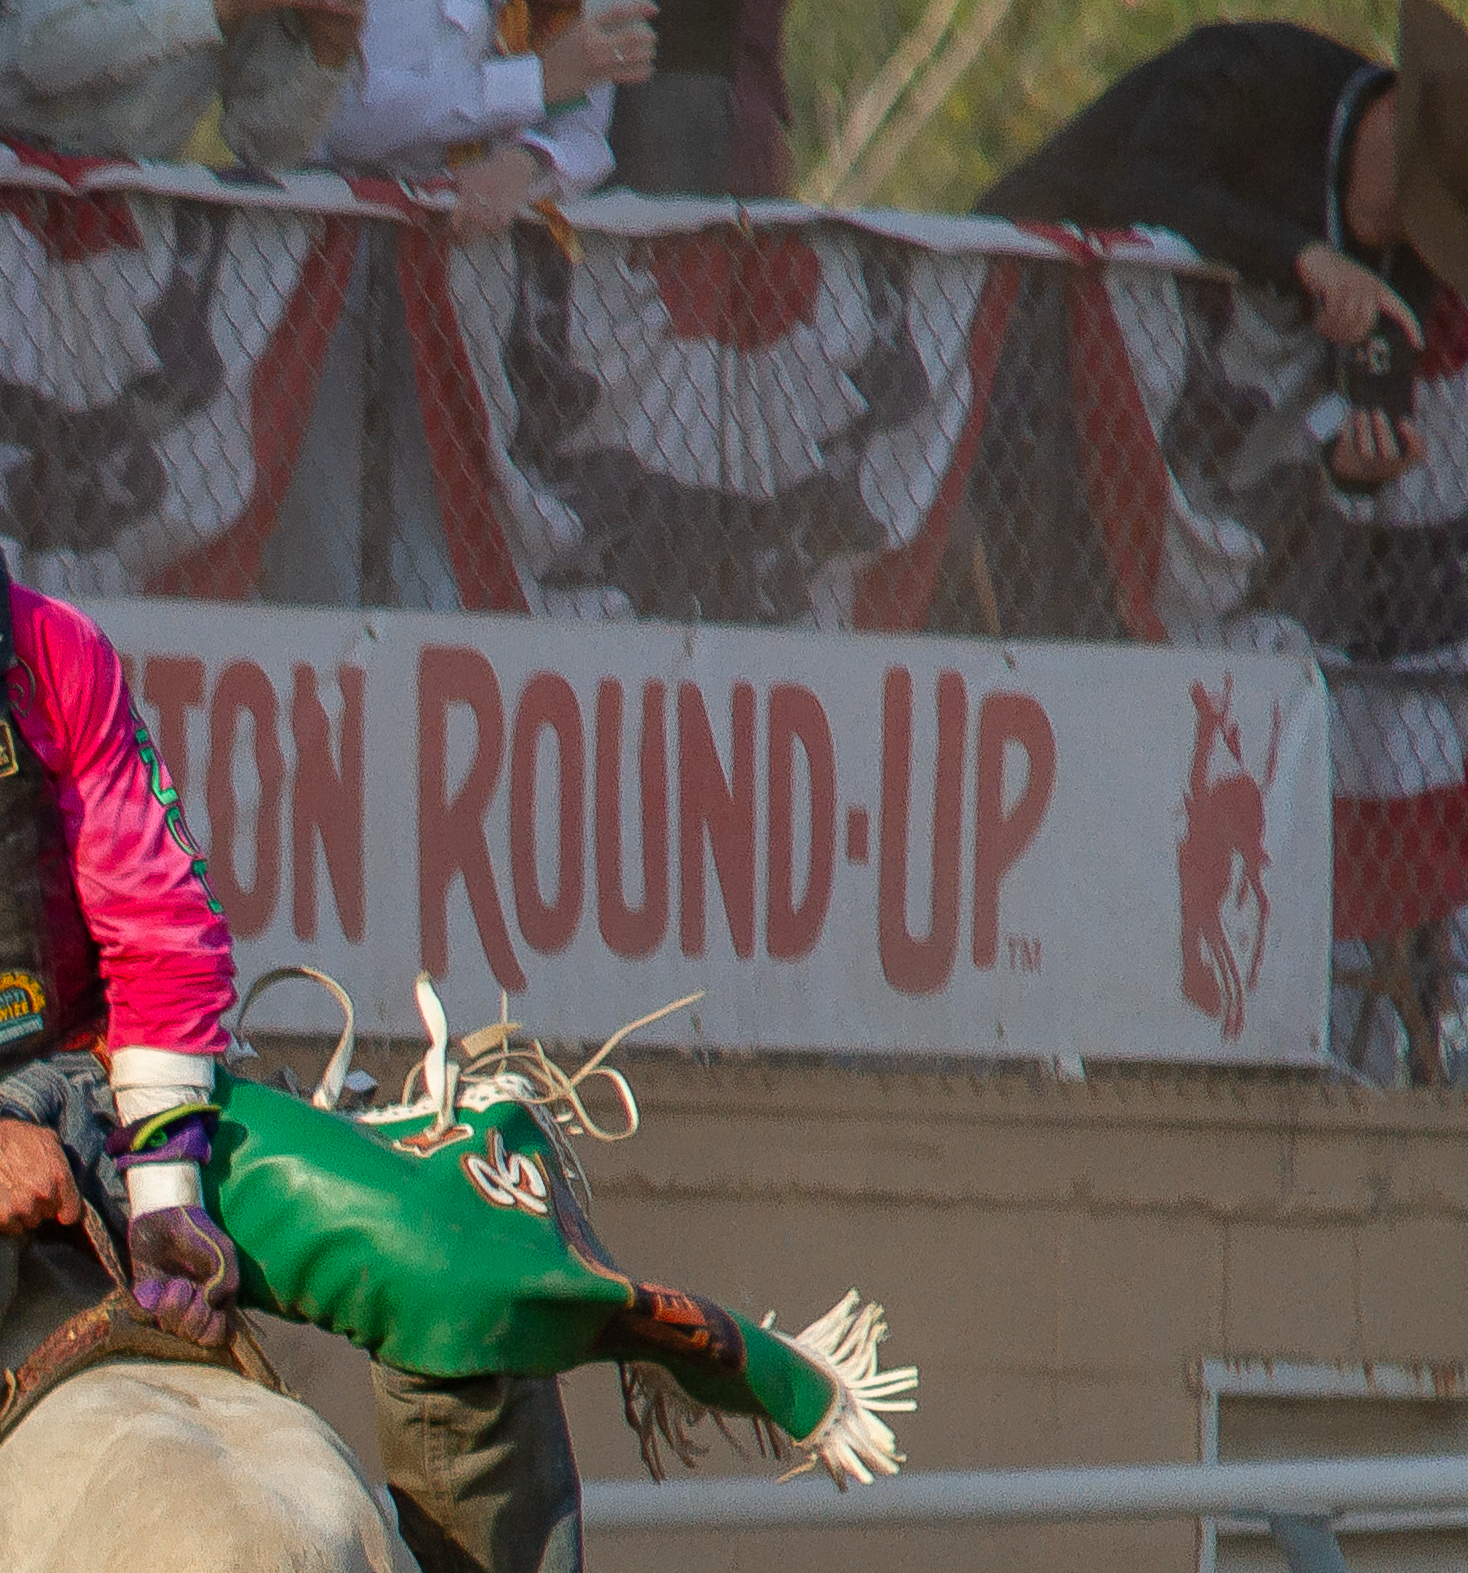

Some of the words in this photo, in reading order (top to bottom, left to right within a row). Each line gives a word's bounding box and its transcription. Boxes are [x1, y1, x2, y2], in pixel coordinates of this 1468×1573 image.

[120, 652, 368, 946] TON
[417, 642, 1057, 997] ROUND-UP
[130, 706, 224, 914] INCH
